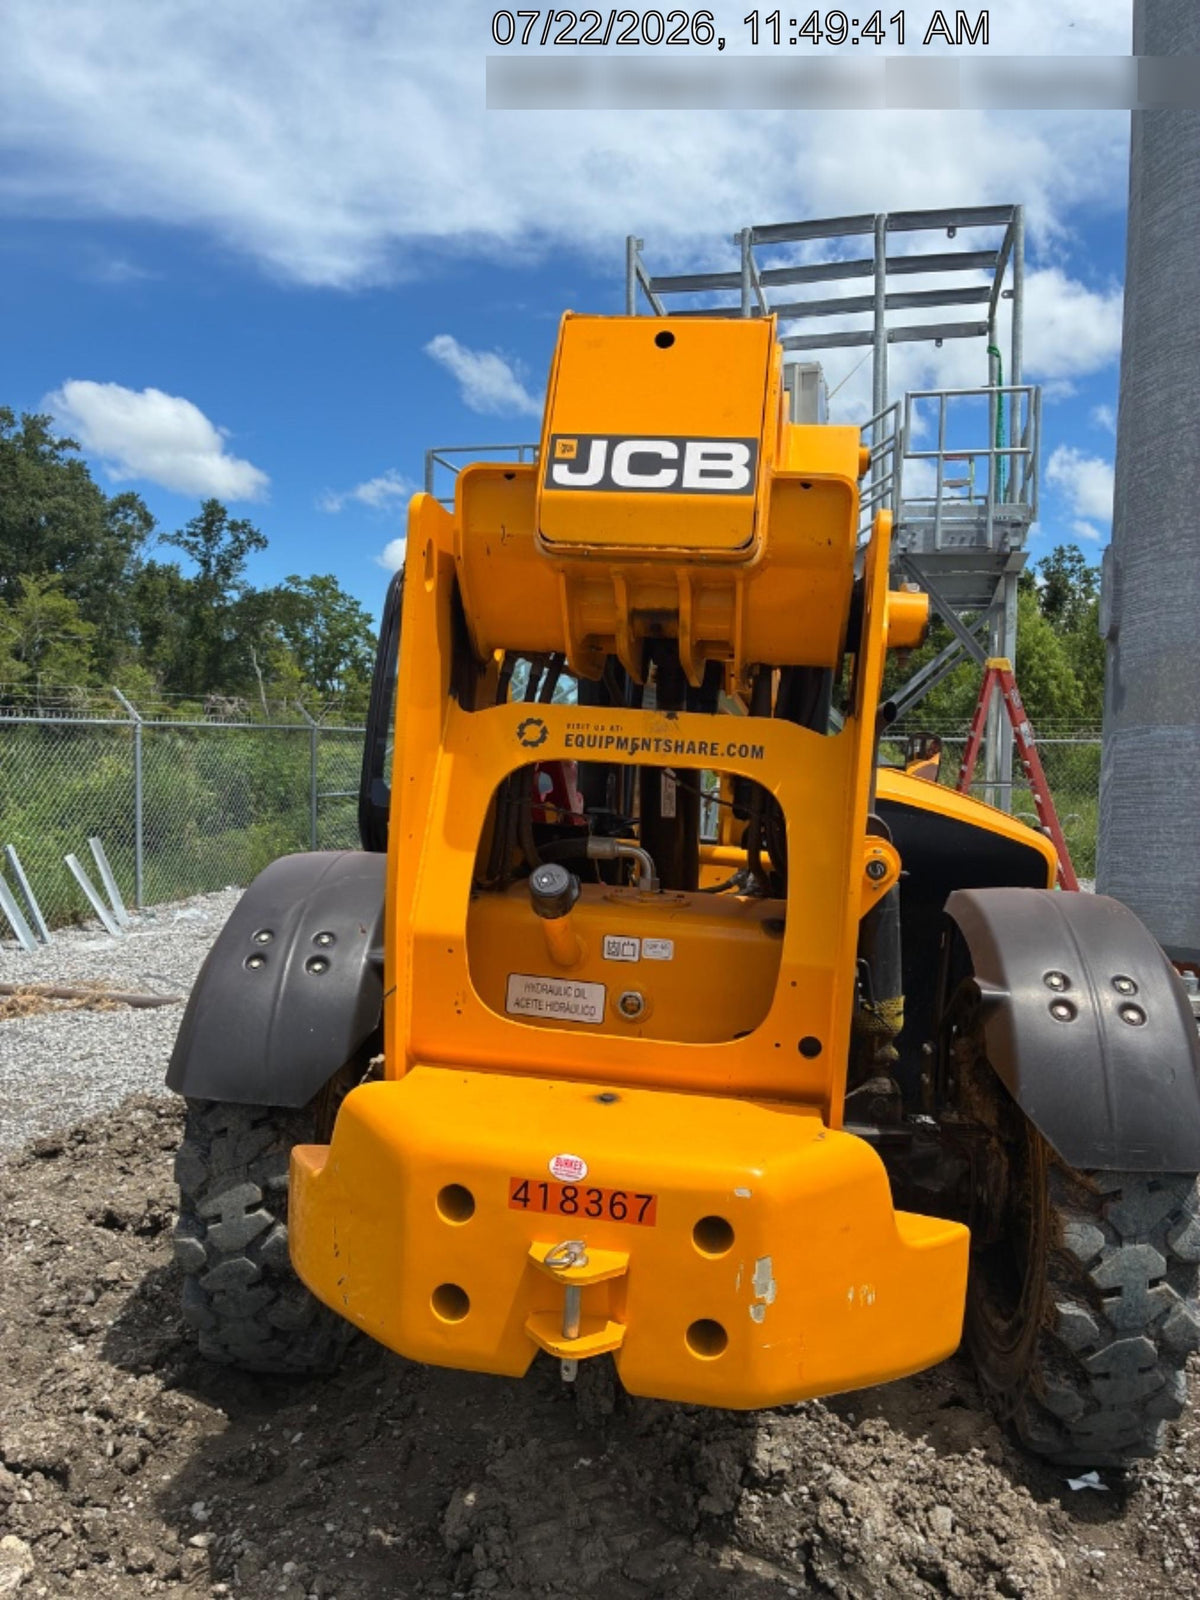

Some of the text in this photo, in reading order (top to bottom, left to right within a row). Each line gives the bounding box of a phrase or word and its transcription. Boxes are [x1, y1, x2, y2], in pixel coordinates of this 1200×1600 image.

[552, 439, 750, 490] JCB
[564, 733, 765, 759] EQUIPMENTSHARE.COM
[524, 982, 588, 999] HYDRAULIC OIL
[513, 997, 544, 1011] ACEITE
[511, 1180, 653, 1223] 418367
